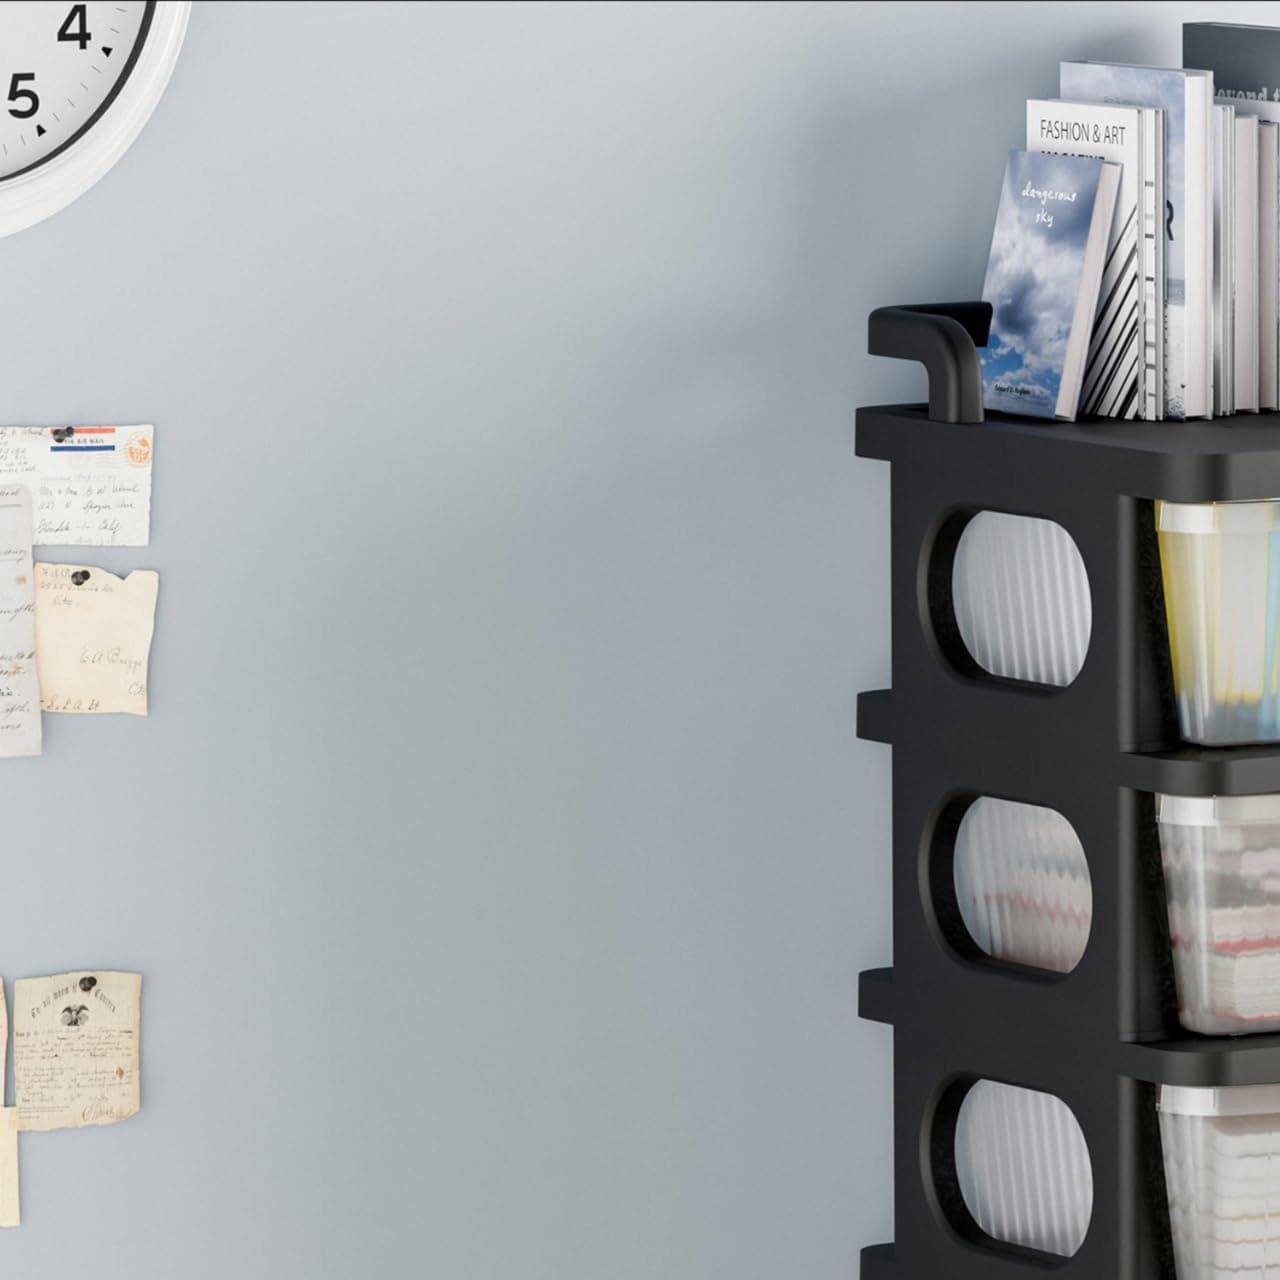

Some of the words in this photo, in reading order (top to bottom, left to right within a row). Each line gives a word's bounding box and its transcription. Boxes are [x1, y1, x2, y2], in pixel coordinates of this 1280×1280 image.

[57, 4, 91, 49] 4
[8, 72, 40, 119] 5
[1041, 120, 1090, 142] FASHION
[1092, 124, 1100, 143] &
[1104, 126, 1126, 145] ART
[1021, 181, 1077, 205] dangerous
[1035, 208, 1054, 228] sky
